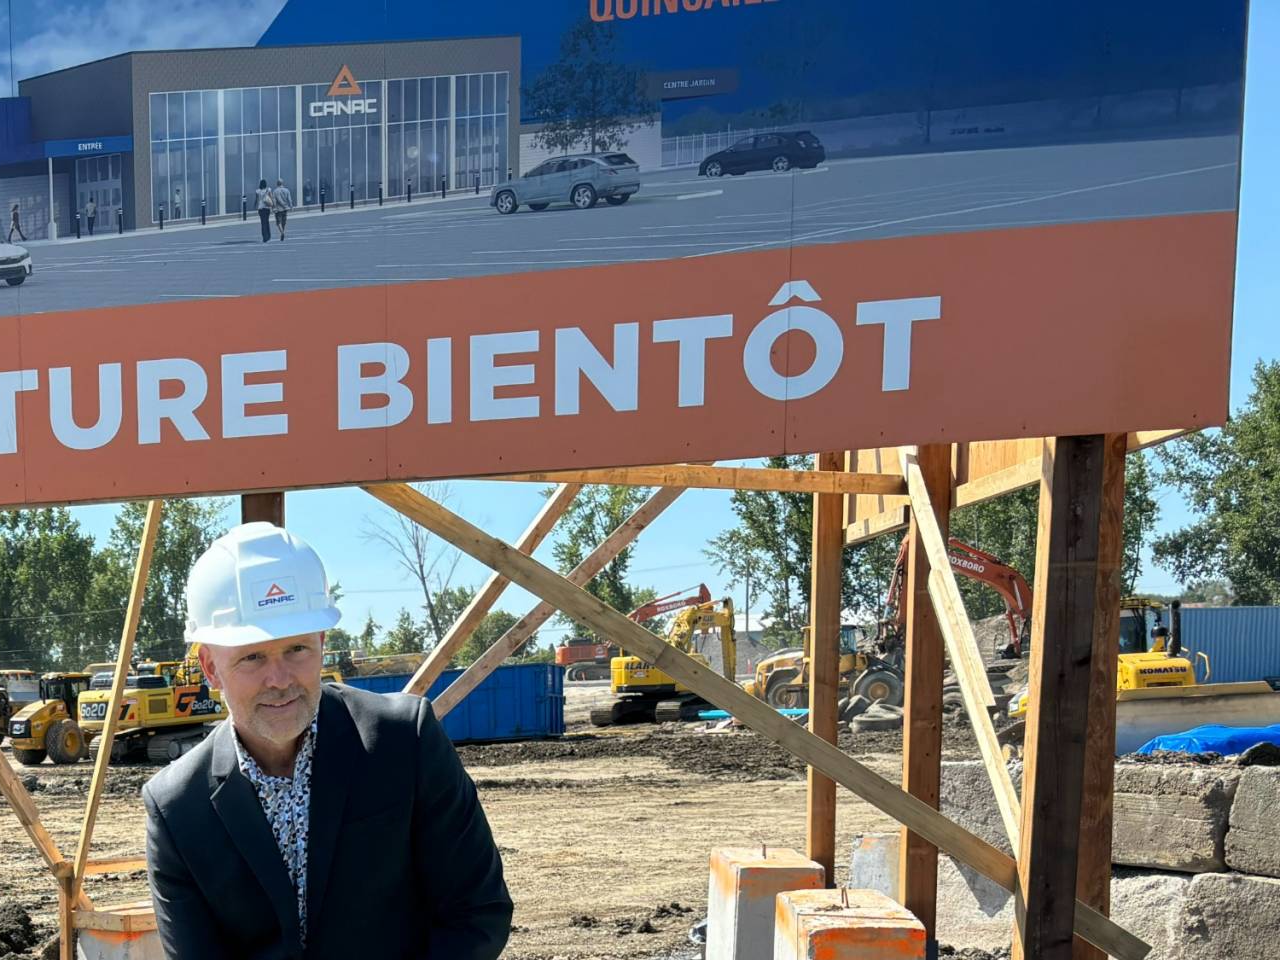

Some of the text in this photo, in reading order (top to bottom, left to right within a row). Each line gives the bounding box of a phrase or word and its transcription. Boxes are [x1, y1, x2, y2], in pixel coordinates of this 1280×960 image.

[309, 98, 377, 117] CANAC
[337, 280, 942, 430] BIENTÔT
[948, 555, 985, 574] OXBORO
[257, 594, 295, 607] CANAC
[1139, 666, 1188, 675] KOMATSU
[81, 703, 107, 718] Go20
